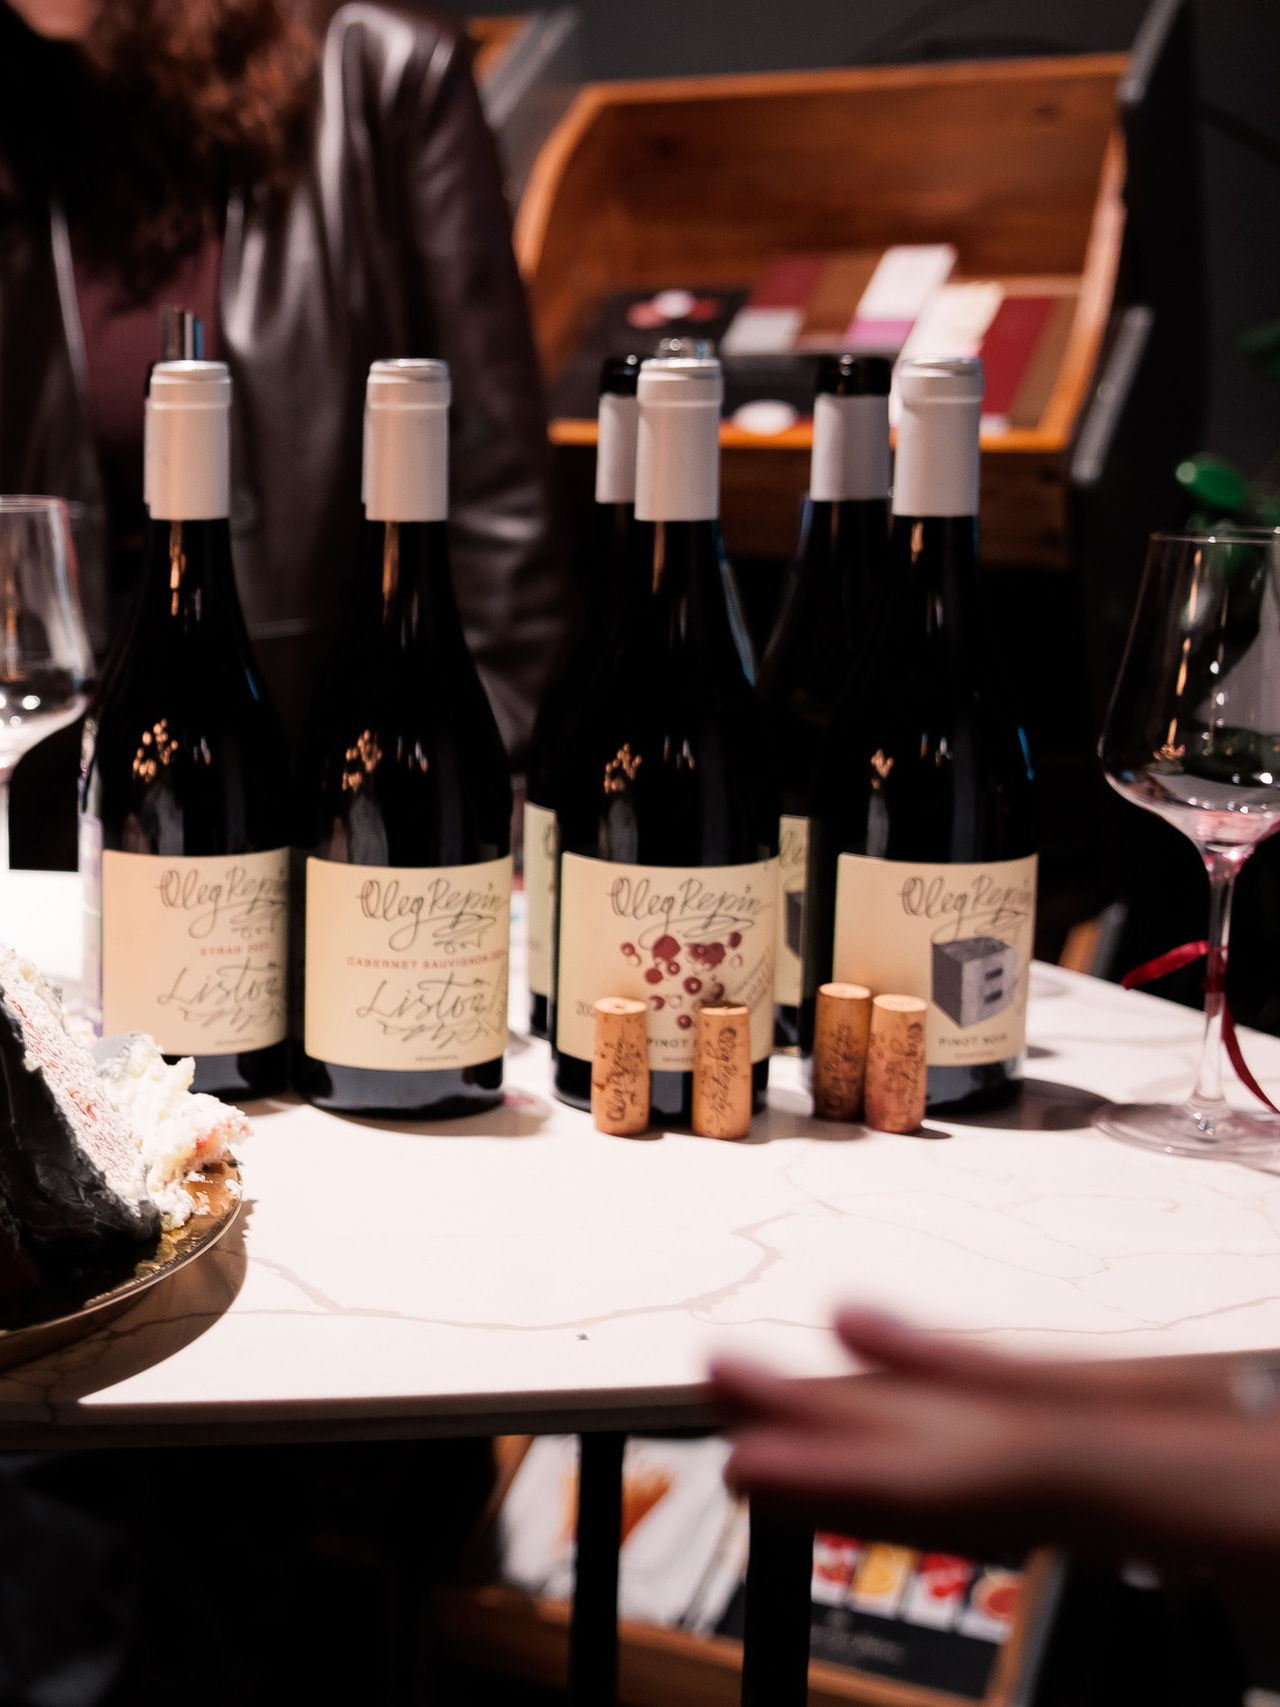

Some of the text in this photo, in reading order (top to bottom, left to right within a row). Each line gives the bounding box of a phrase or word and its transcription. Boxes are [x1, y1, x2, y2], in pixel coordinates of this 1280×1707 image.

[356, 878, 424, 951] Oleg
[606, 876, 675, 950] Oleg
[346, 955, 417, 970] CABERNET
[422, 952, 488, 970] SAUVIGNON
[645, 1036, 688, 1049] PINOT
[938, 1035, 979, 1047] PINOT
